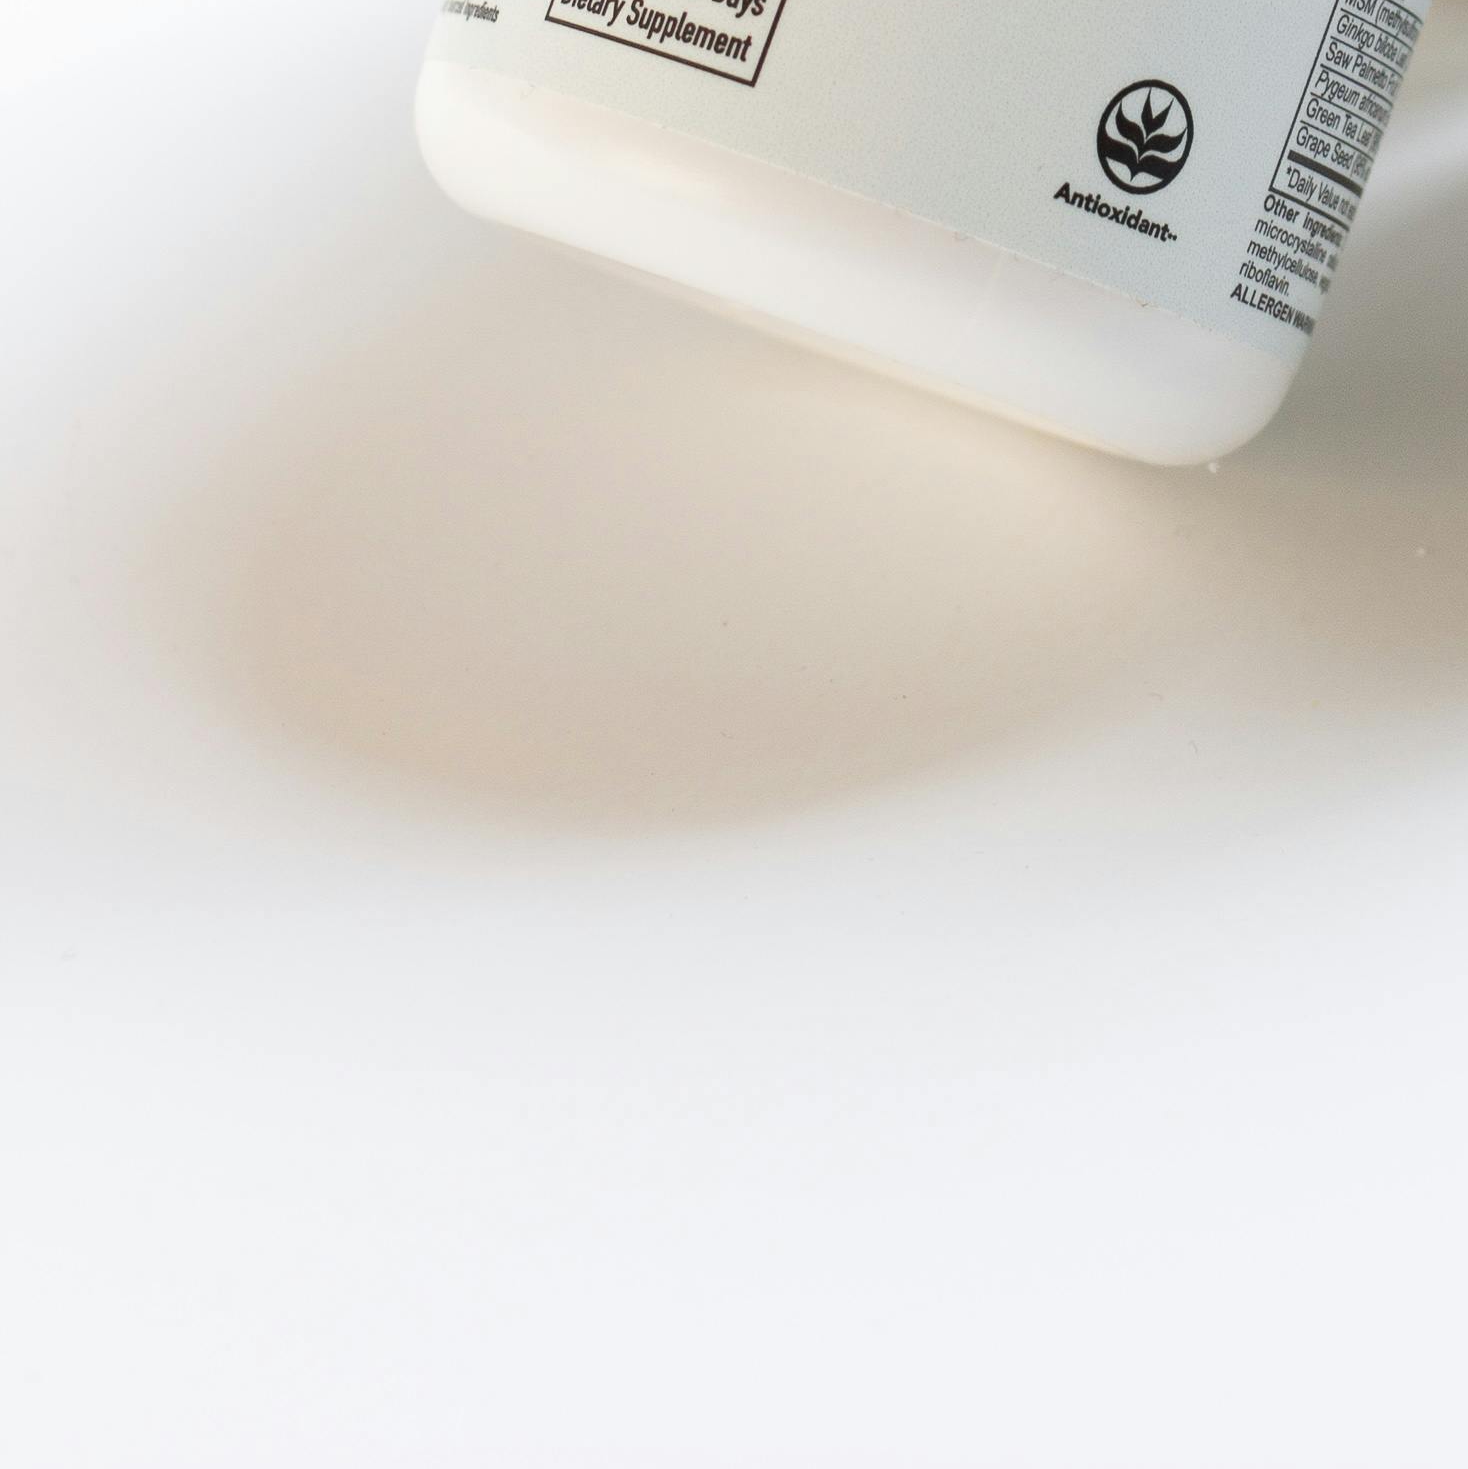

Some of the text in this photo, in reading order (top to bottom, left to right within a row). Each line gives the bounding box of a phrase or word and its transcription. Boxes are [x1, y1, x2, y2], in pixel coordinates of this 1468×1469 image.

[1336, 13, 1374, 50] Ginkgo
[1326, 41, 1353, 65] Saw
[1315, 69, 1362, 105] Pygeum
[1305, 97, 1341, 131] Green
[1295, 125, 1332, 159] Grape
[1263, 193, 1300, 224] Other
[1230, 282, 1293, 325] ALLERGEN
